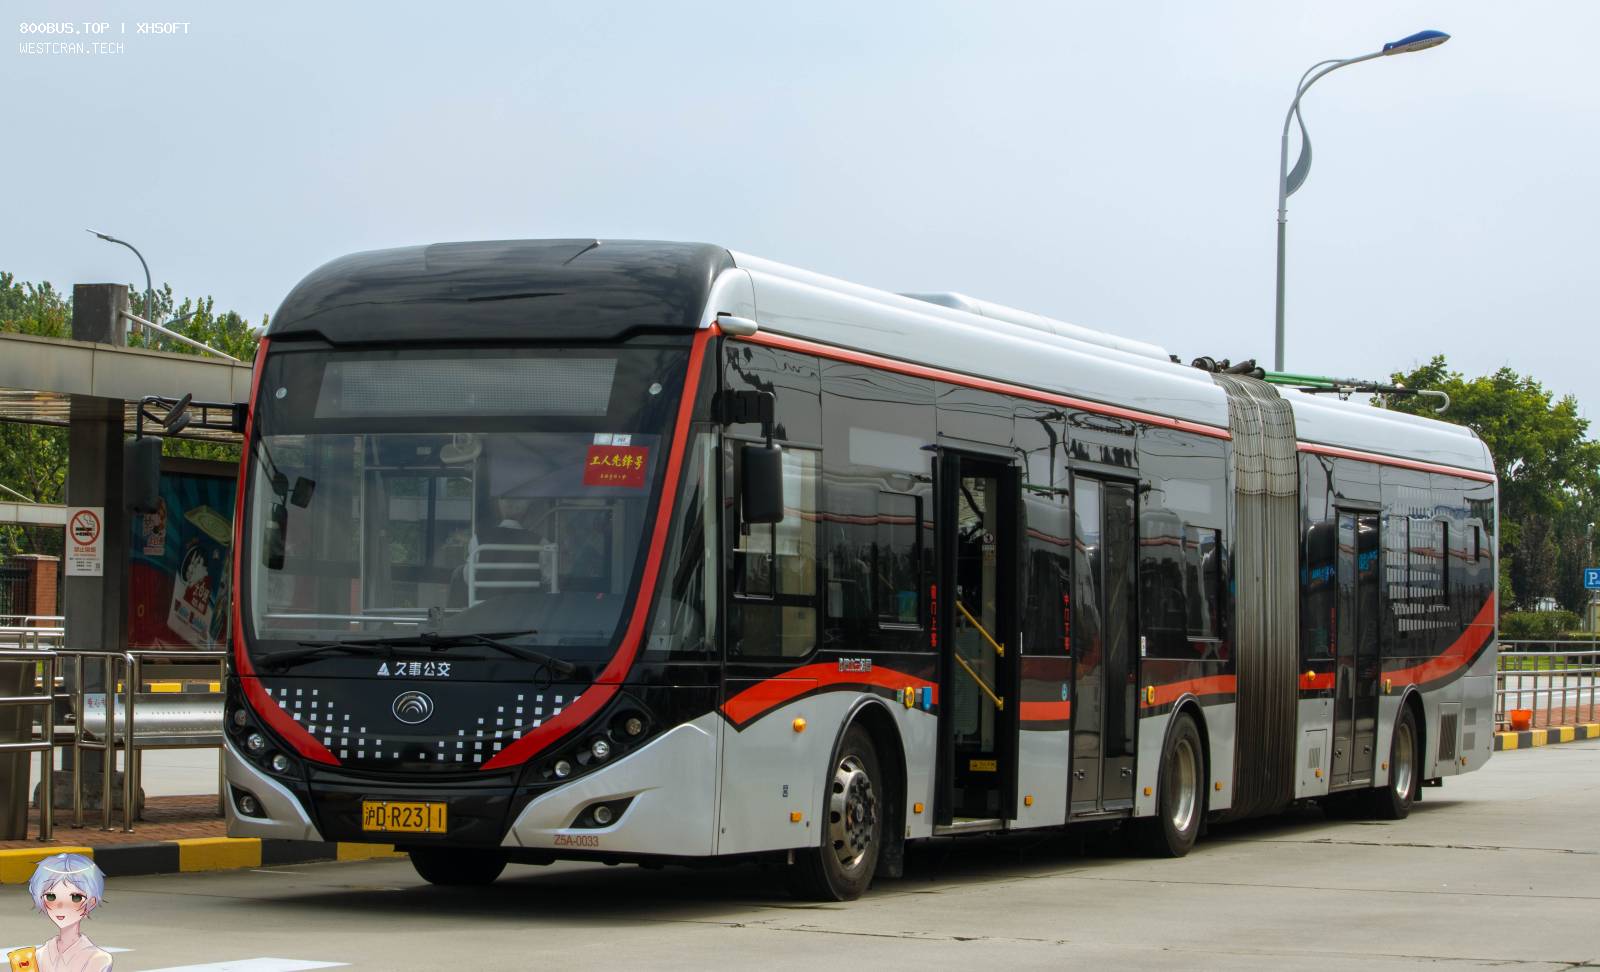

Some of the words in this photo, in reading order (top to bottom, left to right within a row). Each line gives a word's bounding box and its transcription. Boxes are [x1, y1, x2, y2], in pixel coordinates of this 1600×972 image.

[589, 453, 644, 470] 工人先锋号
[394, 661, 452, 677] 久事公交
[553, 834, 599, 848] Z5A-0033
